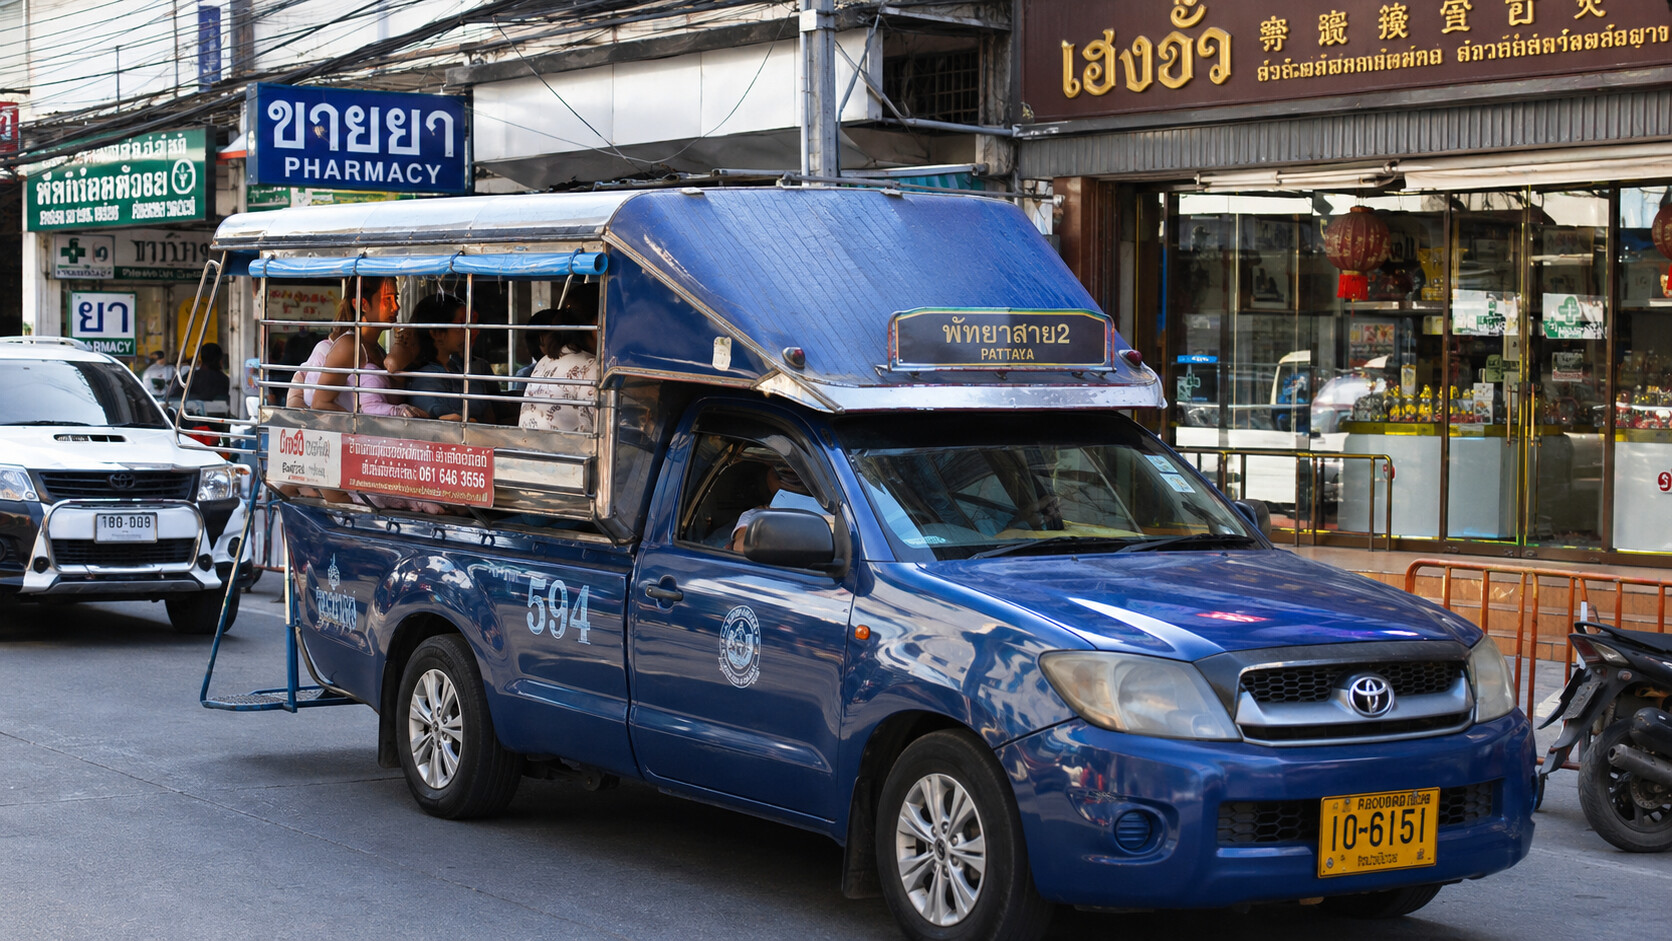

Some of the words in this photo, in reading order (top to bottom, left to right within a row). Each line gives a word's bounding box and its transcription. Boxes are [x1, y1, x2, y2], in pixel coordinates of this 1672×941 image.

[267, 100, 454, 157] ขายยา
[285, 156, 442, 184] PHARMACY
[78, 301, 128, 333] ยา
[942, 316, 1070, 344] พัทยาสาย2
[84, 341, 132, 353] ARMACY
[981, 348, 1035, 360] PATTAYA
[419, 466, 436, 483] 061
[439, 468, 458, 486] 646
[460, 470, 485, 489] 3656
[526, 576, 591, 645] 594
[1332, 807, 1426, 851] 10-6151
